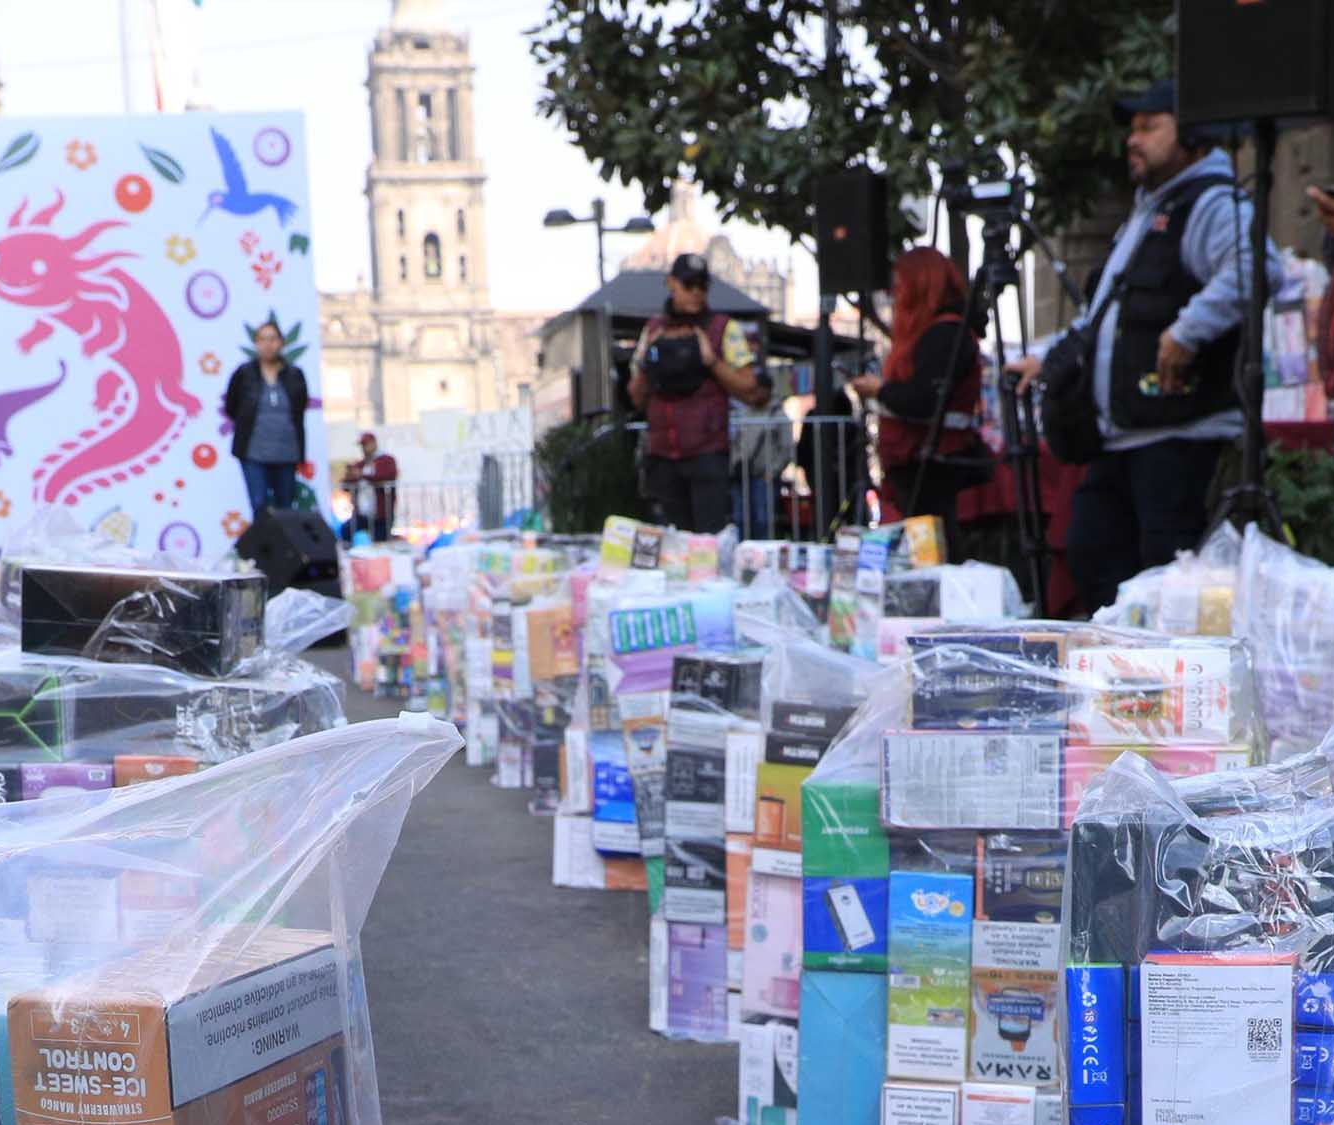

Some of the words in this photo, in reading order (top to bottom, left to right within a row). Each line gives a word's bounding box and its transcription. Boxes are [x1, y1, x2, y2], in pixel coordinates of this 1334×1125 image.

[243, 981, 285, 1006] addictive
[196, 998, 242, 1025] chemical.
[247, 1004, 284, 1030] contains
[204, 1018, 246, 1046] nicotine.
[251, 1022, 301, 1057] WARNING:
[39, 1047, 136, 1072] CONTROL
[34, 1071, 147, 1097] ICE-SWEET
[40, 1098, 76, 1115] MANGO
[78, 1102, 143, 1116] STRAWBERRY
